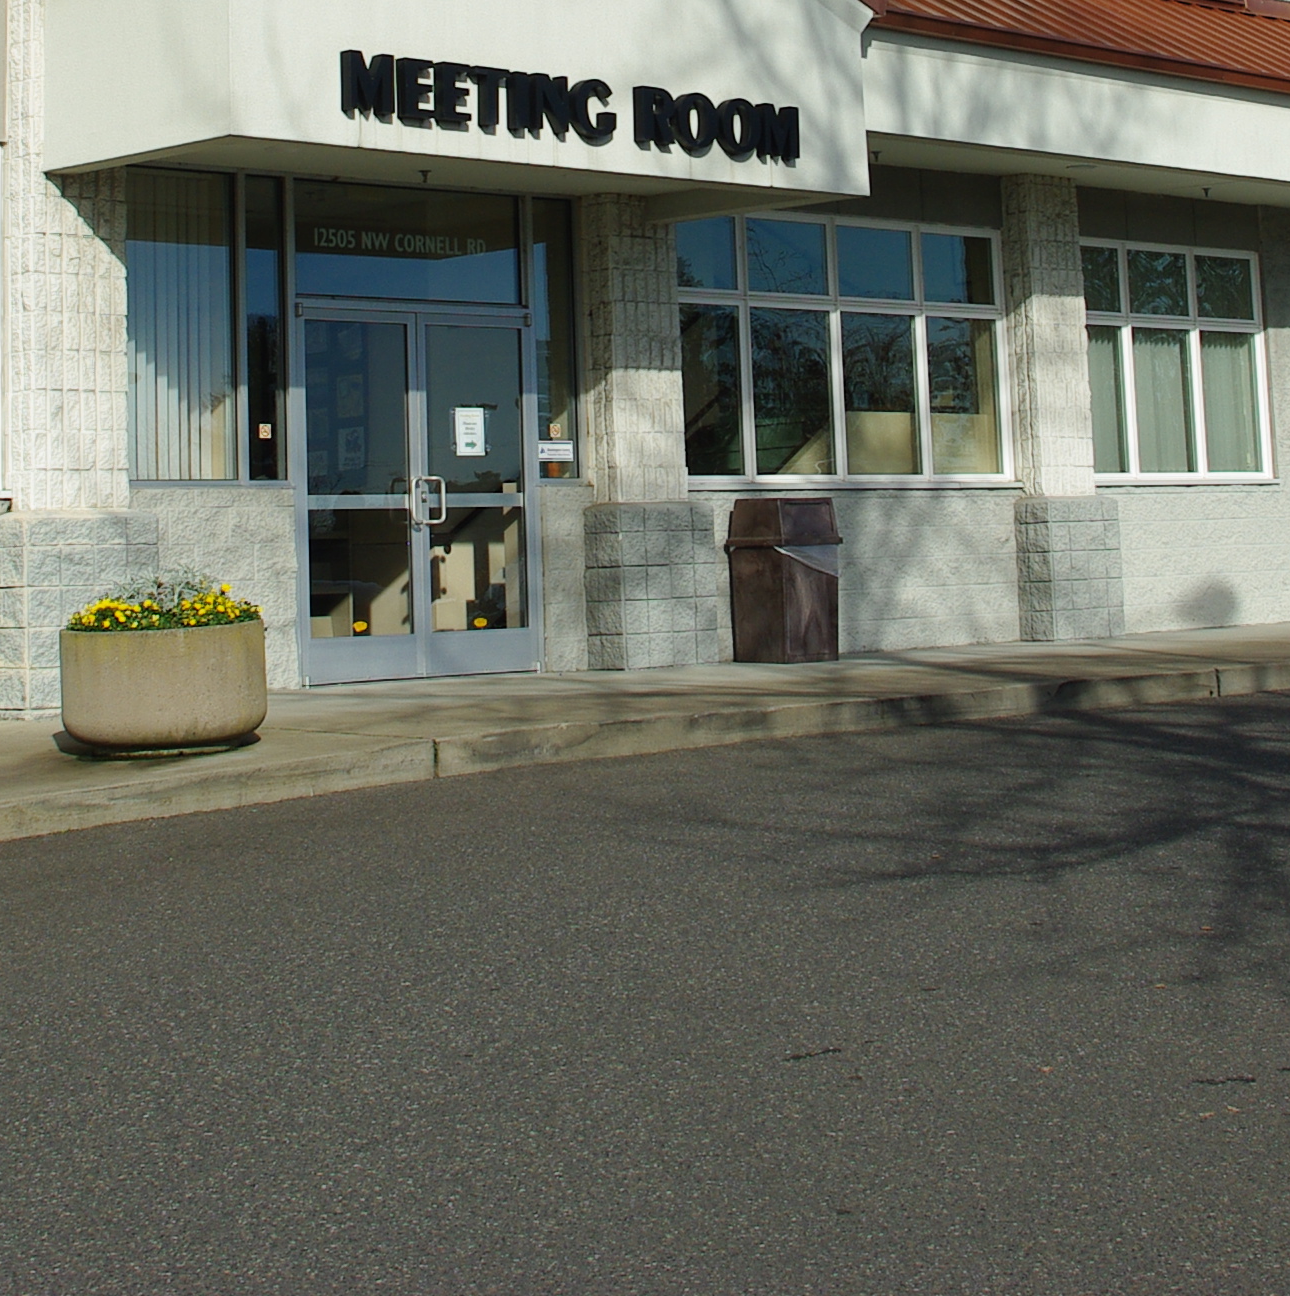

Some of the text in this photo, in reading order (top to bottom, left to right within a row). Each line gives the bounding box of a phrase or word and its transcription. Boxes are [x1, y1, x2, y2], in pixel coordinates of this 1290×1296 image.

[340, 50, 800, 167] MEETING ROOM
[314, 227, 487, 256] 12505 NW CORNELL RD
